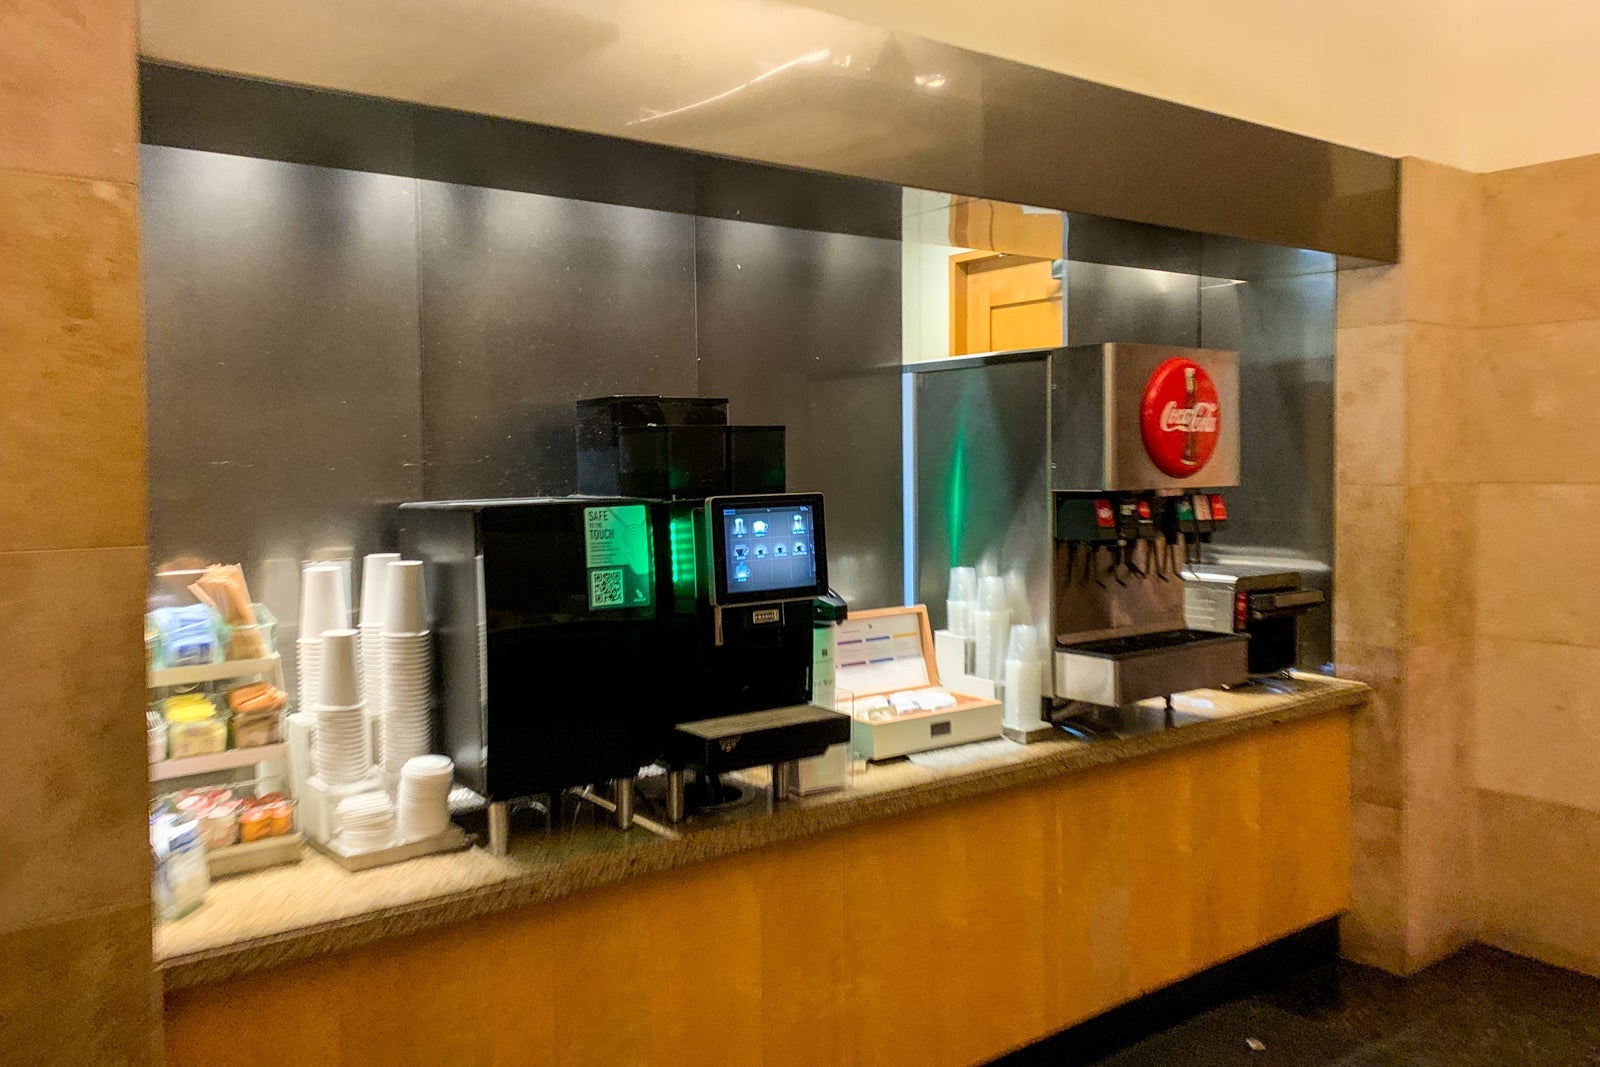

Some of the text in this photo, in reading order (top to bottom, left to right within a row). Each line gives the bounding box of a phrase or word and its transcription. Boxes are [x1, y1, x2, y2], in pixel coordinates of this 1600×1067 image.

[1160, 401, 1216, 432] Coca-Cola
[588, 510, 609, 521] SAFE
[589, 528, 615, 540] TOUCH
